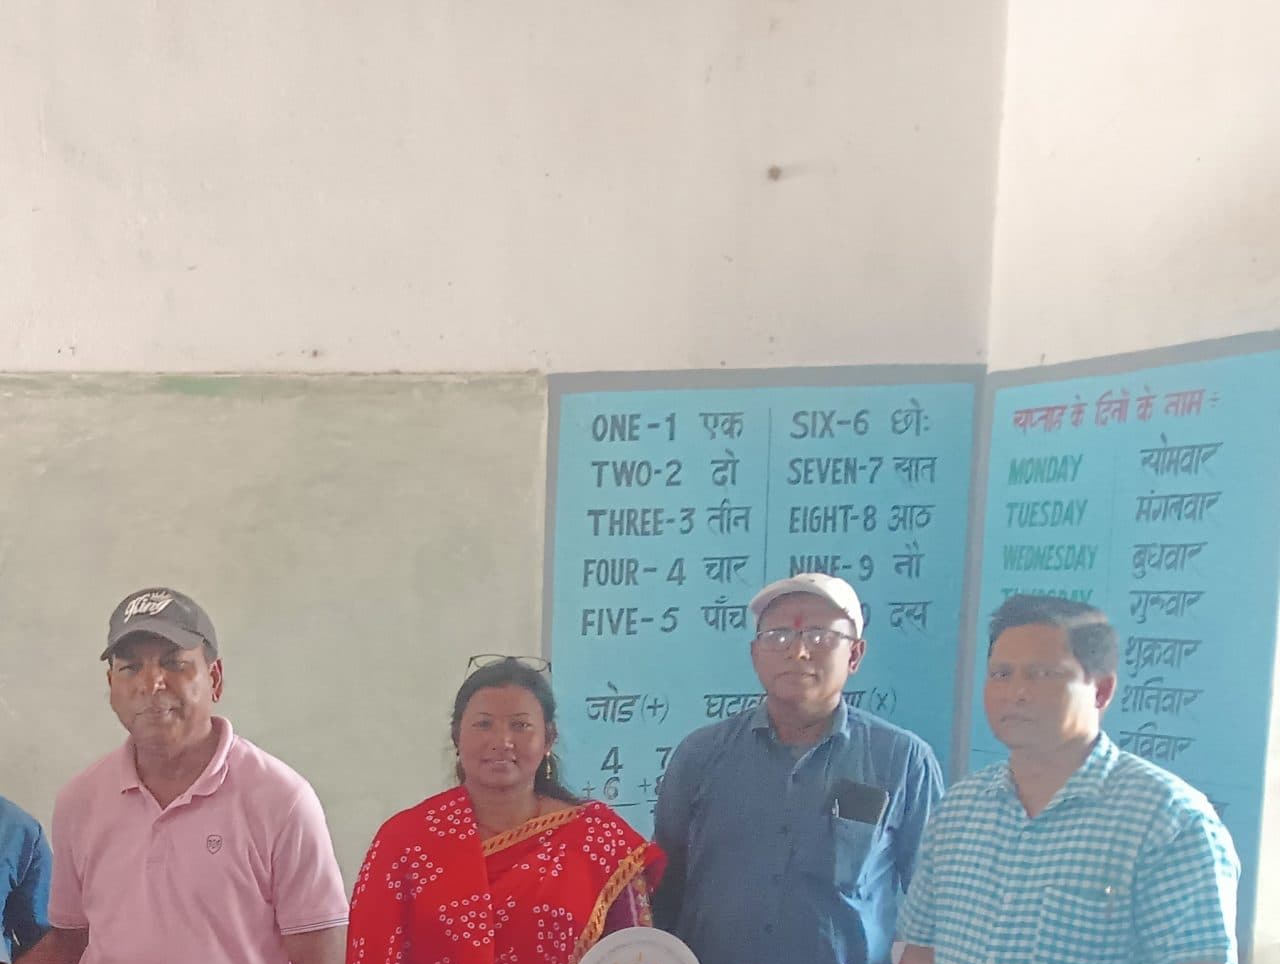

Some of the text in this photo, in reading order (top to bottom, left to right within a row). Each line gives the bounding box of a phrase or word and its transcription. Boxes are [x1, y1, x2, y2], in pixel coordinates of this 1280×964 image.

[1071, 394, 1088, 427] के
[1136, 386, 1157, 421] के
[1164, 388, 1207, 416] नाम
[699, 411, 745, 440] एक
[789, 409, 870, 439] SIX-6
[710, 447, 740, 486] दो
[786, 456, 884, 485] SEVEN-7
[1008, 453, 1084, 485] MONDAY
[1140, 432, 1223, 478] सोमवार
[591, 458, 683, 488] TWO-2
[706, 497, 753, 535] तीन
[789, 504, 877, 534] EIGHT-8
[887, 504, 936, 532] आठ
[1005, 498, 1089, 528] TUESDAY
[1136, 488, 1223, 521] मंगलवार
[586, 507, 696, 537] THREE-3
[703, 555, 752, 586] चार
[893, 539, 925, 579] नौ
[1002, 543, 1099, 571] WEDNESDAY
[1132, 541, 1209, 580] बुधवार
[887, 600, 933, 634] दस
[1125, 635, 1203, 678] शुक्रवार
[1121, 676, 1205, 716] शनिवार
[600, 746, 624, 774] 4
